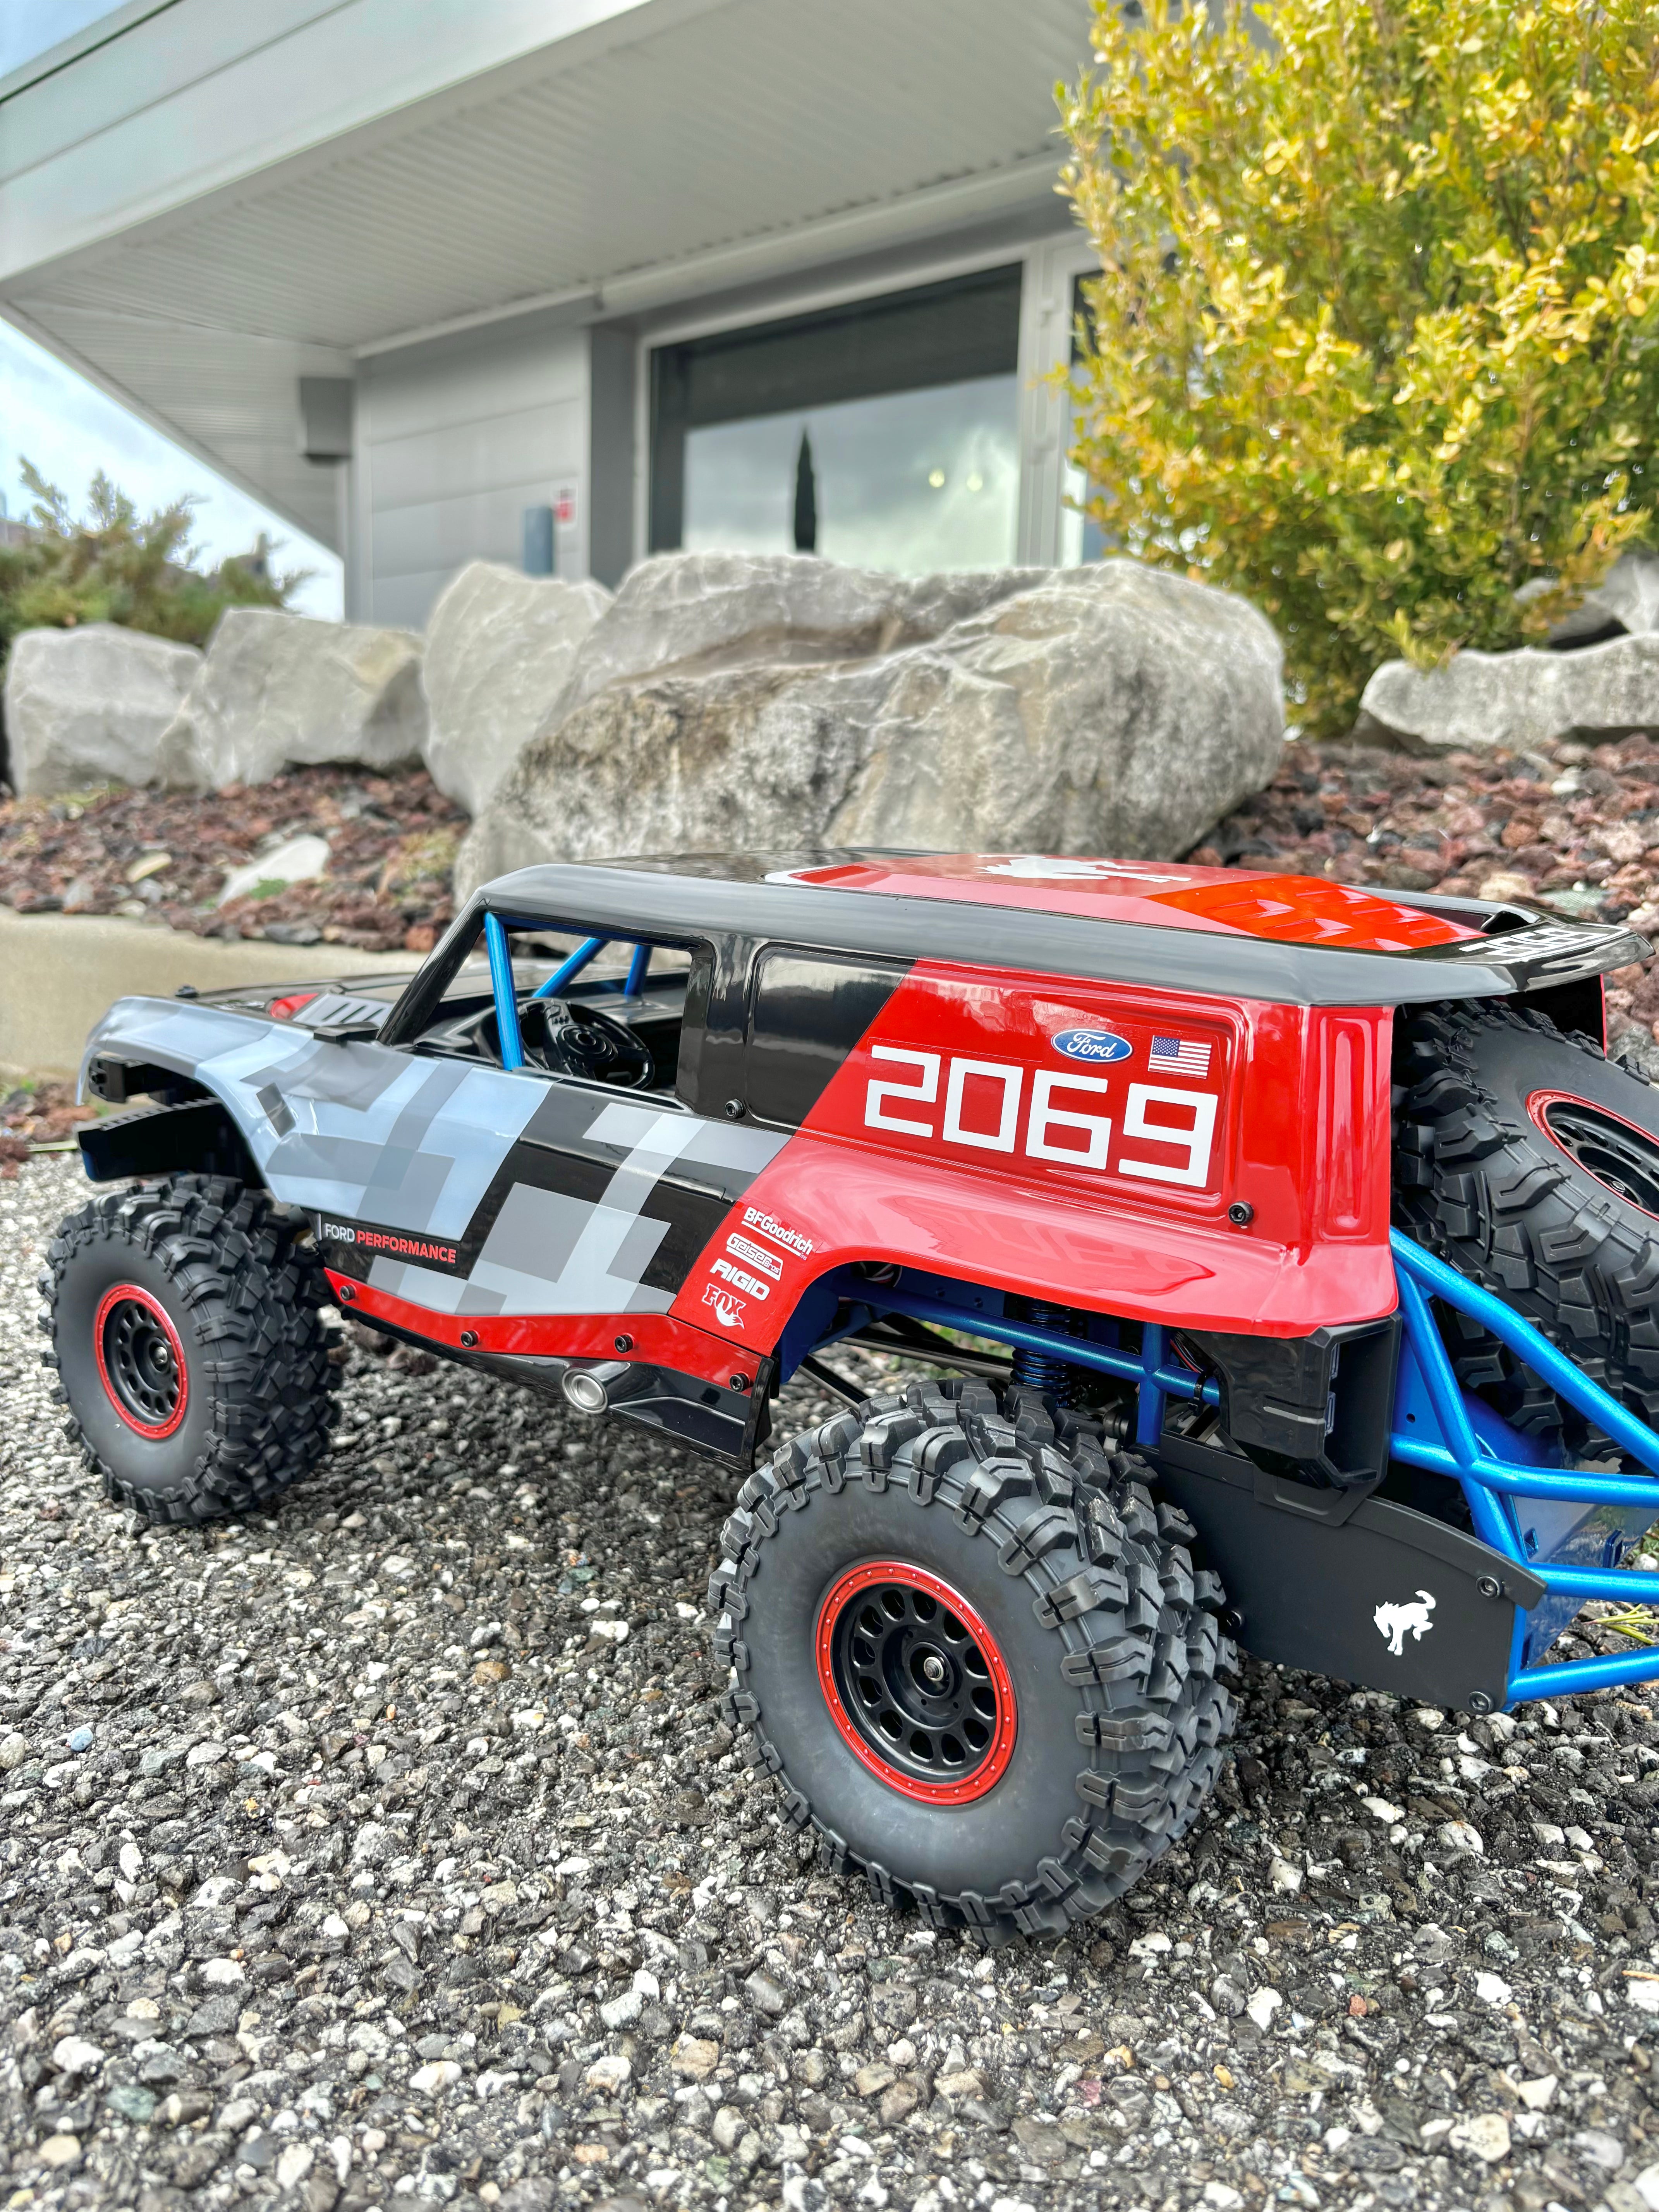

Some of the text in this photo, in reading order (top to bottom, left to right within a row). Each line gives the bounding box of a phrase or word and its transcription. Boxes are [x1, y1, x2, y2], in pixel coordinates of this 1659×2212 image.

[1458, 928, 1609, 957] 2069
[1067, 1032, 1117, 1058] Ford
[864, 1045, 1218, 1188] 2069
[325, 1223, 457, 1264] FORD PERFORMANCE
[744, 1207, 812, 1255] BFGoodrich
[701, 1283, 747, 1316] FOX
[710, 1258, 770, 1301] RIGID
